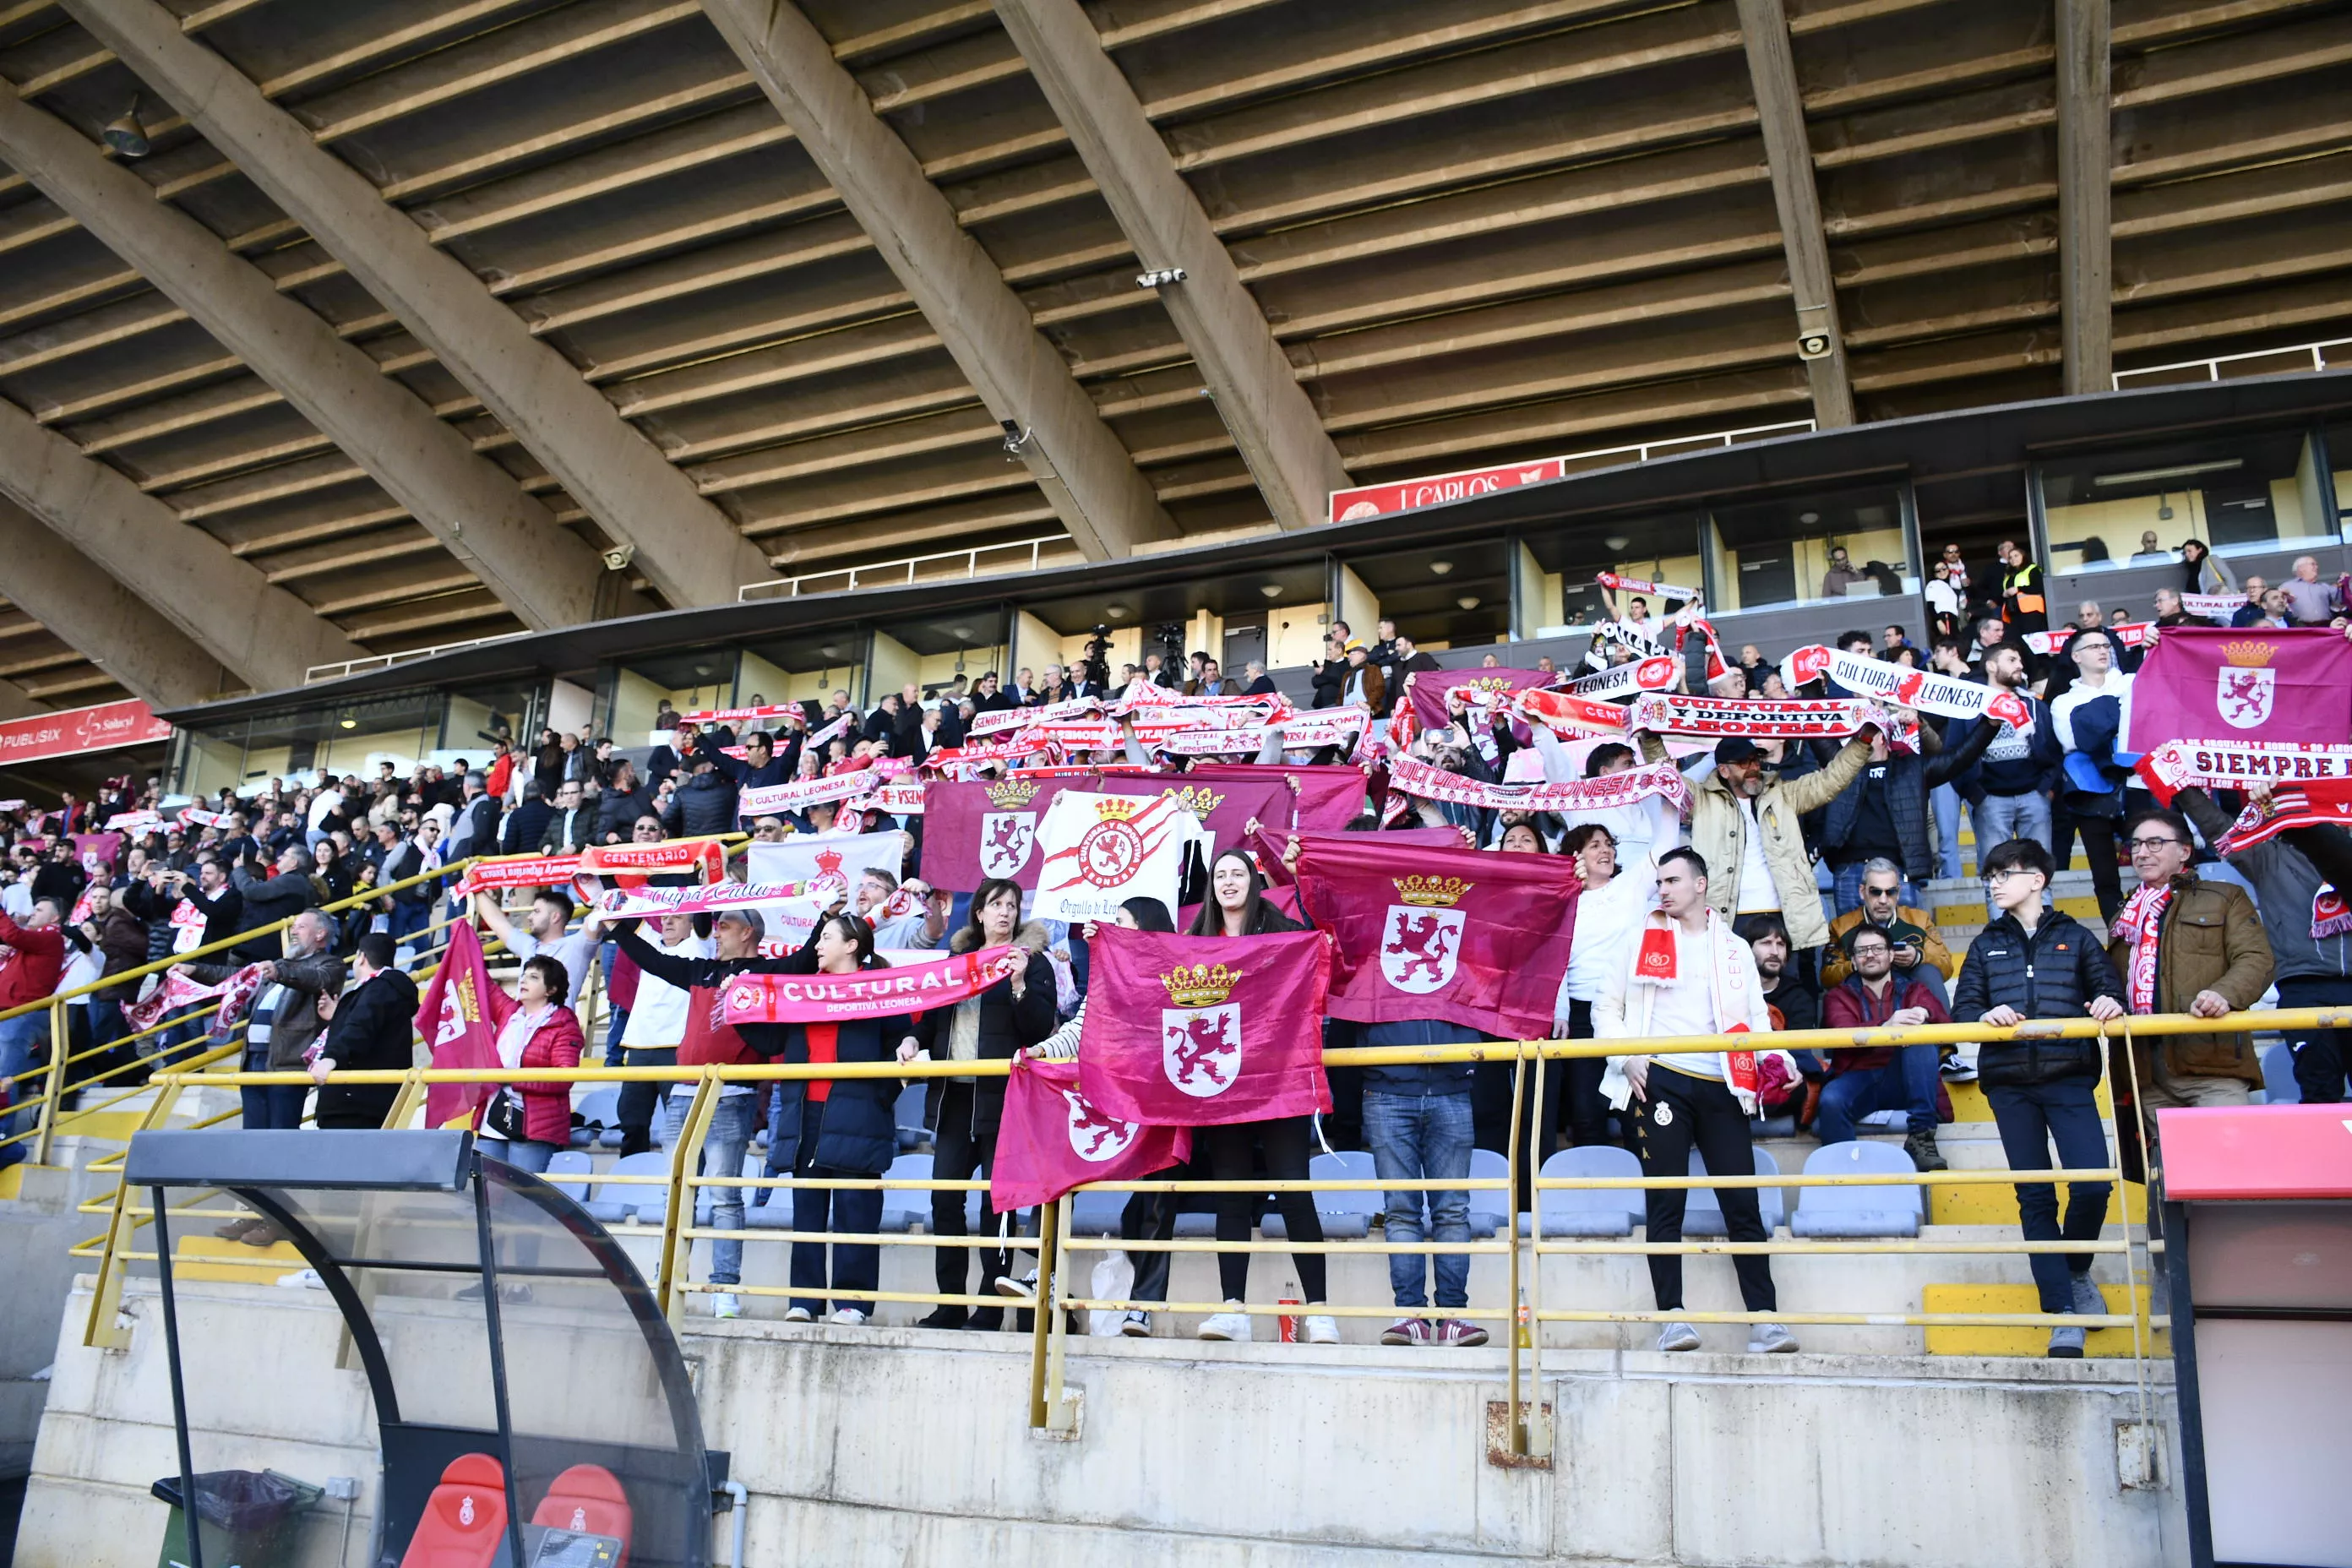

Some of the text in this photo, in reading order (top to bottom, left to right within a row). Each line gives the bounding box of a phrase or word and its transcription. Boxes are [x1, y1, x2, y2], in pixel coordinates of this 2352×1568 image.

[1576, 671, 1629, 694] LEONESA
[1837, 660, 1984, 709] CULTURAL LEONESA
[1669, 697, 1850, 711] CULTURAL
[1673, 708, 1846, 721] Y DEPORTIVA
[1669, 717, 1851, 734] LEONESA
[3, 727, 62, 749] PUBLISIX
[2197, 751, 2333, 778] SIEMPRE
[755, 790, 801, 805] CULTURAL
[803, 780, 846, 795] LEONESA
[1530, 773, 1635, 798] LEONESA
[603, 848, 689, 863] CENTENARIO
[1082, 866, 1136, 886] LEONESA
[1059, 898, 1092, 917] Orgullo
[781, 914, 817, 928] CULTURAL
[783, 967, 963, 1002] CULTURAL
[826, 996, 923, 1013] DEPORTIVA LEONESA
